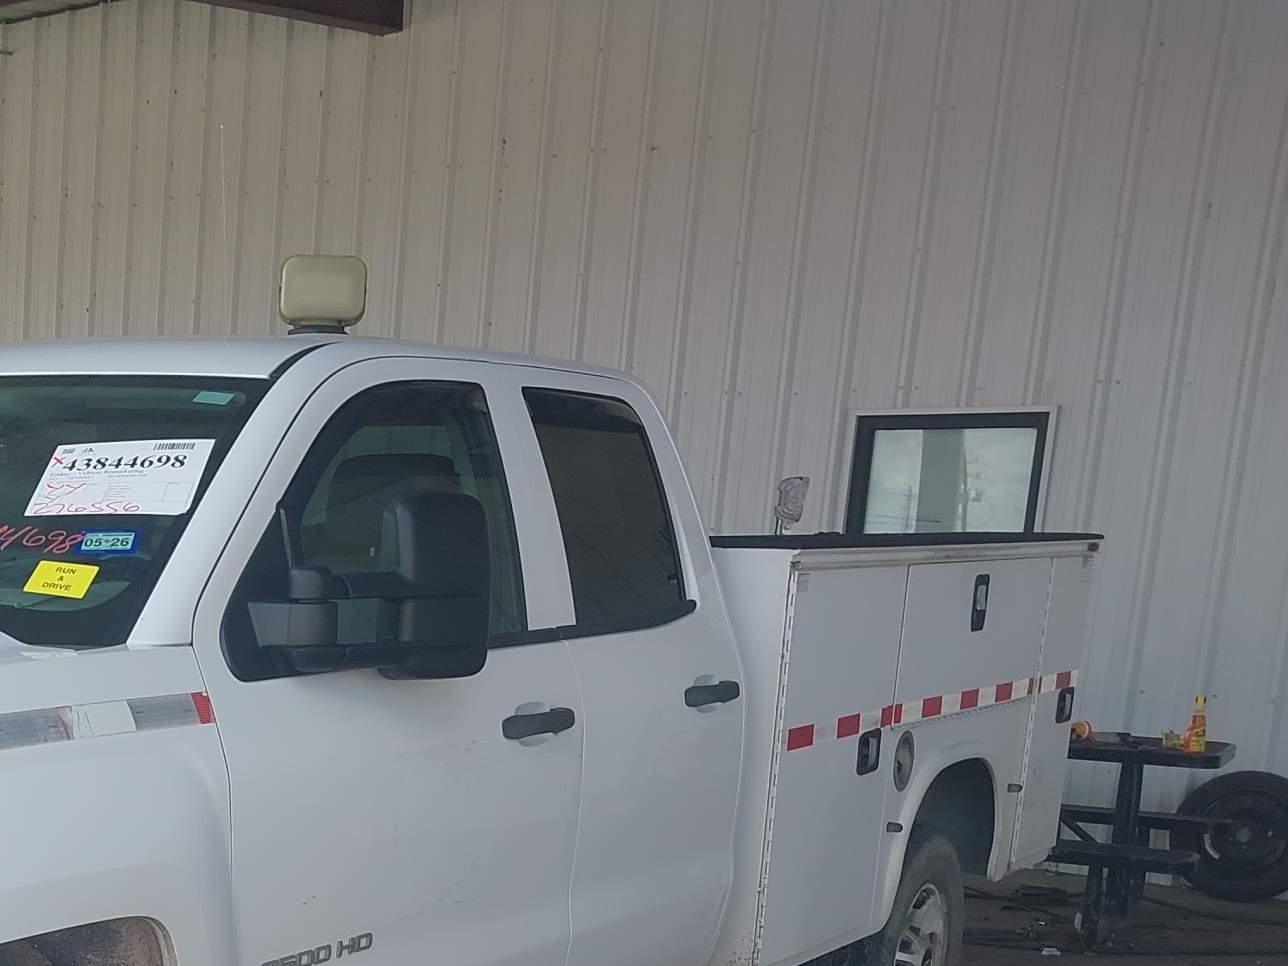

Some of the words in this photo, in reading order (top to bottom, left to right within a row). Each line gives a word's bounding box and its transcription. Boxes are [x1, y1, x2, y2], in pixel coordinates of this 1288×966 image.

[63, 454, 188, 471] 43844698
[83, 537, 103, 548] 05
[111, 537, 131, 547] 26
[55, 566, 77, 575] RUN
[41, 581, 73, 592] DRIVE
[336, 932, 373, 959] HD
